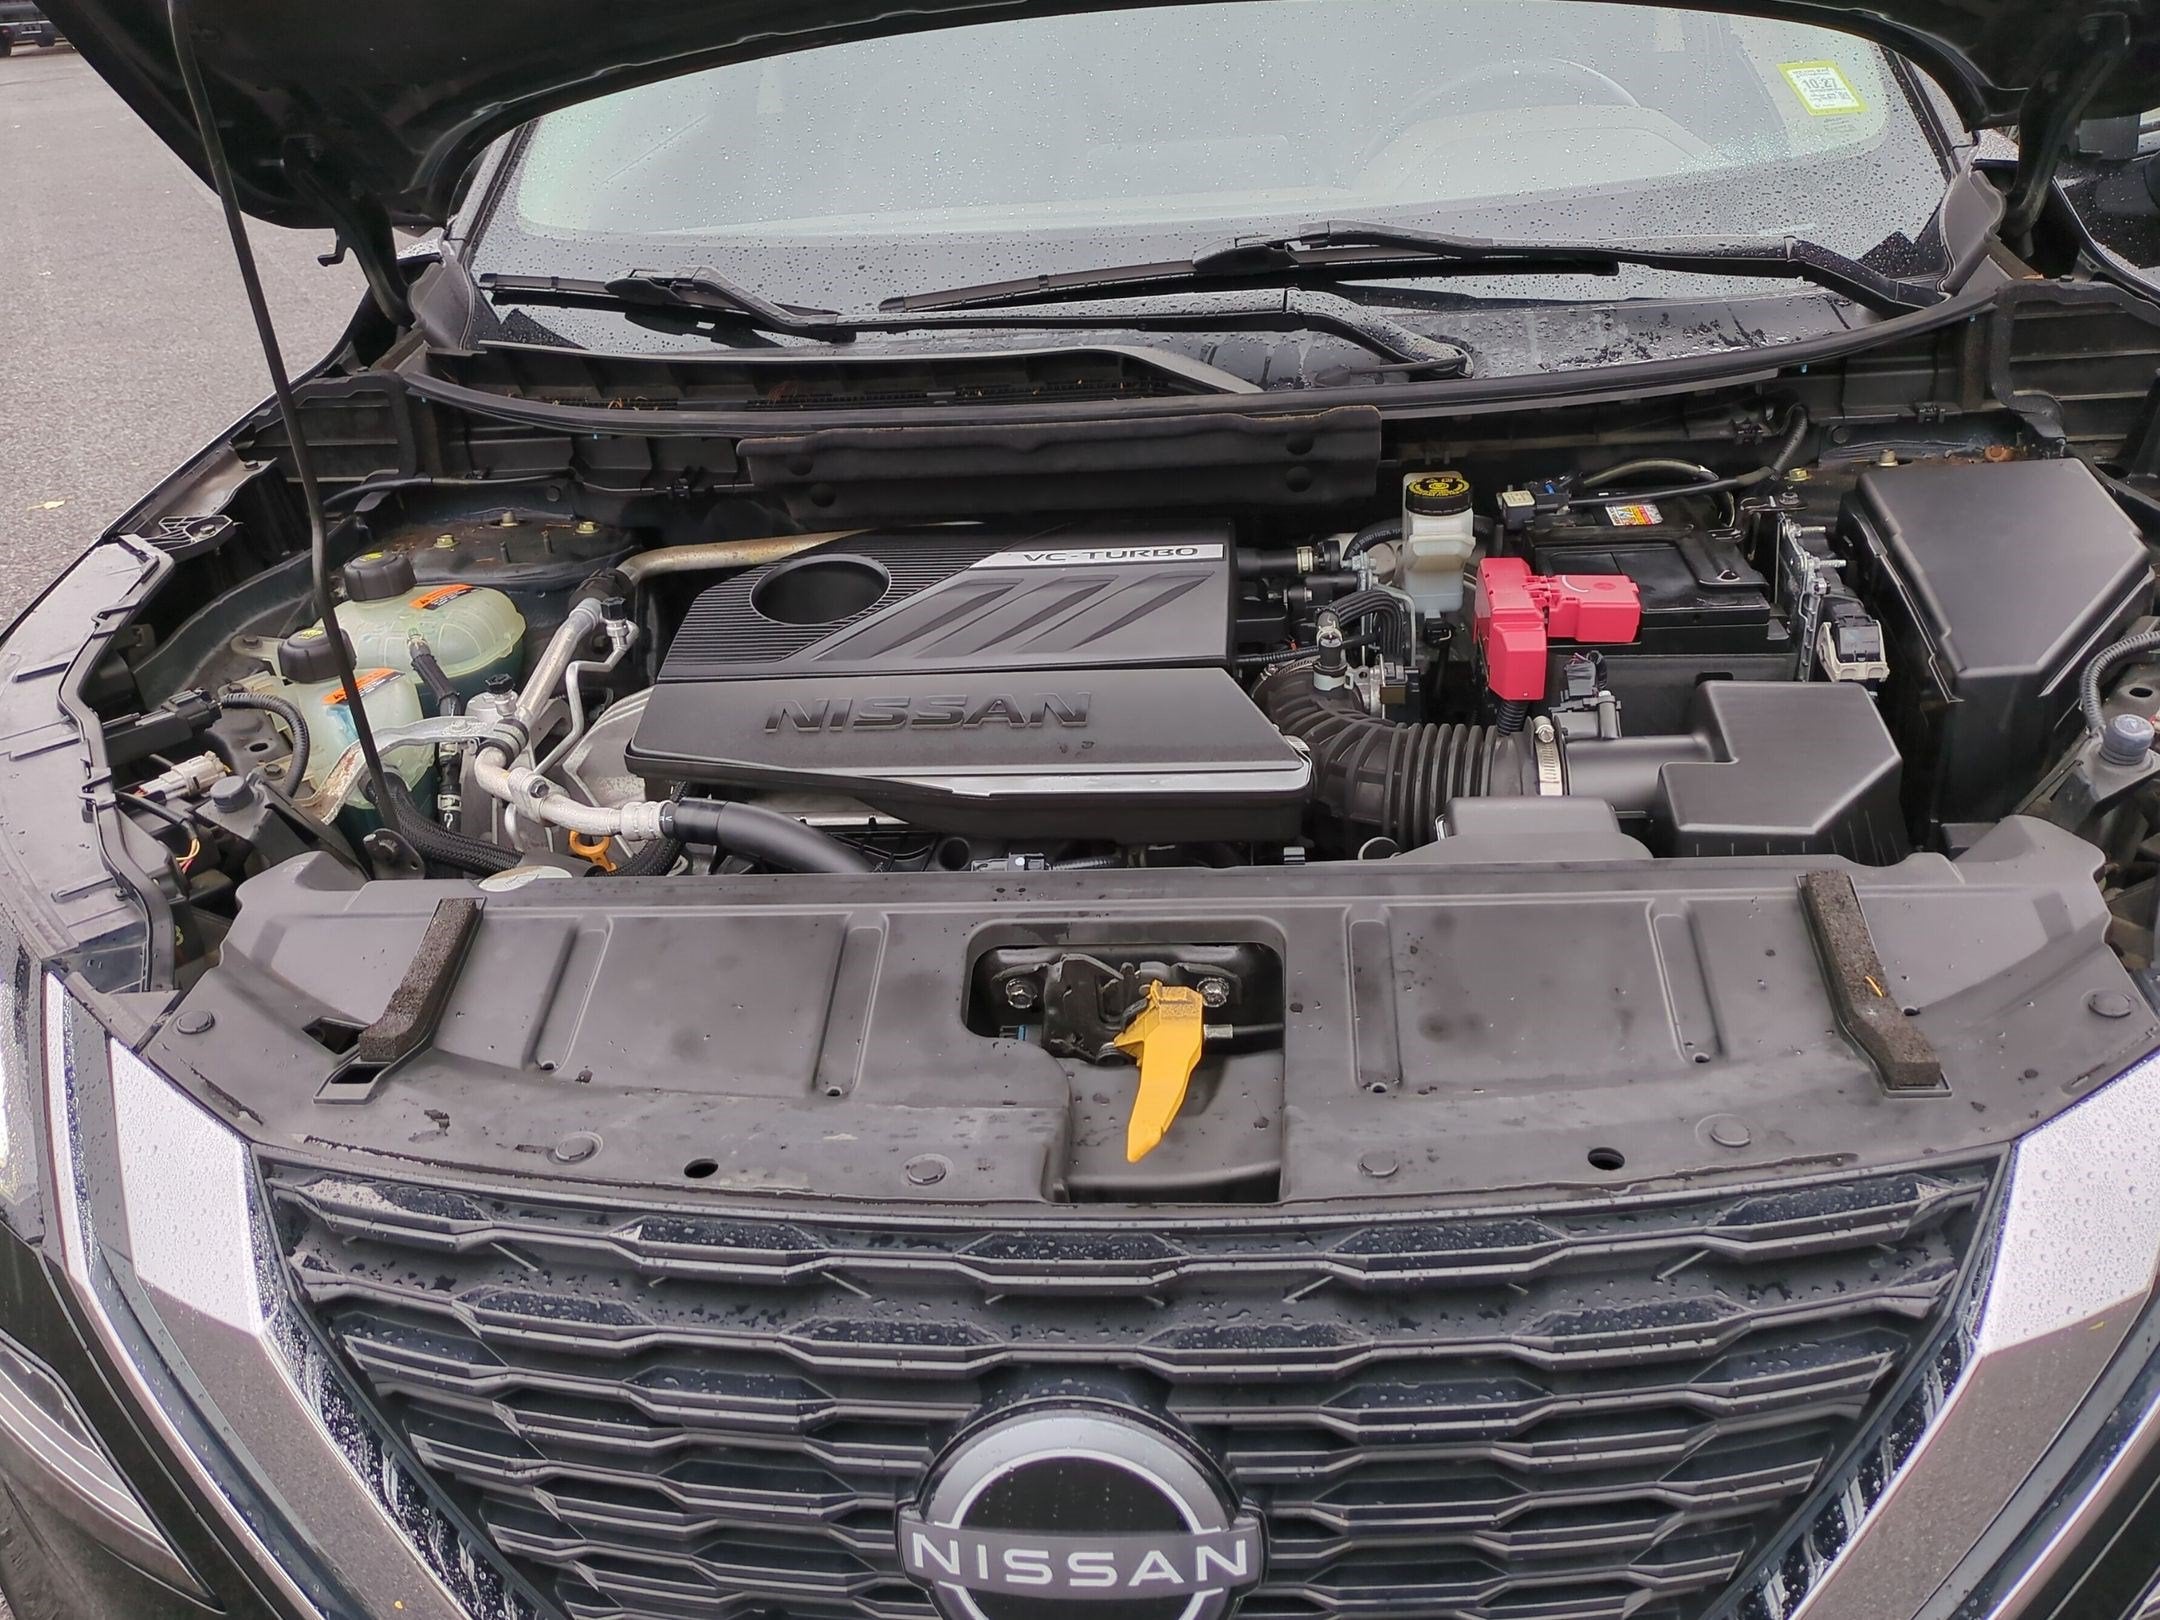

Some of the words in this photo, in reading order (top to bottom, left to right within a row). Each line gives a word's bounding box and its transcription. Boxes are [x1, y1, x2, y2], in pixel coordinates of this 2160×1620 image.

[1023, 547, 1199, 562] VC-TURBO
[764, 692, 1092, 734] NISSAN
[912, 1532, 1248, 1587] NISSAN
